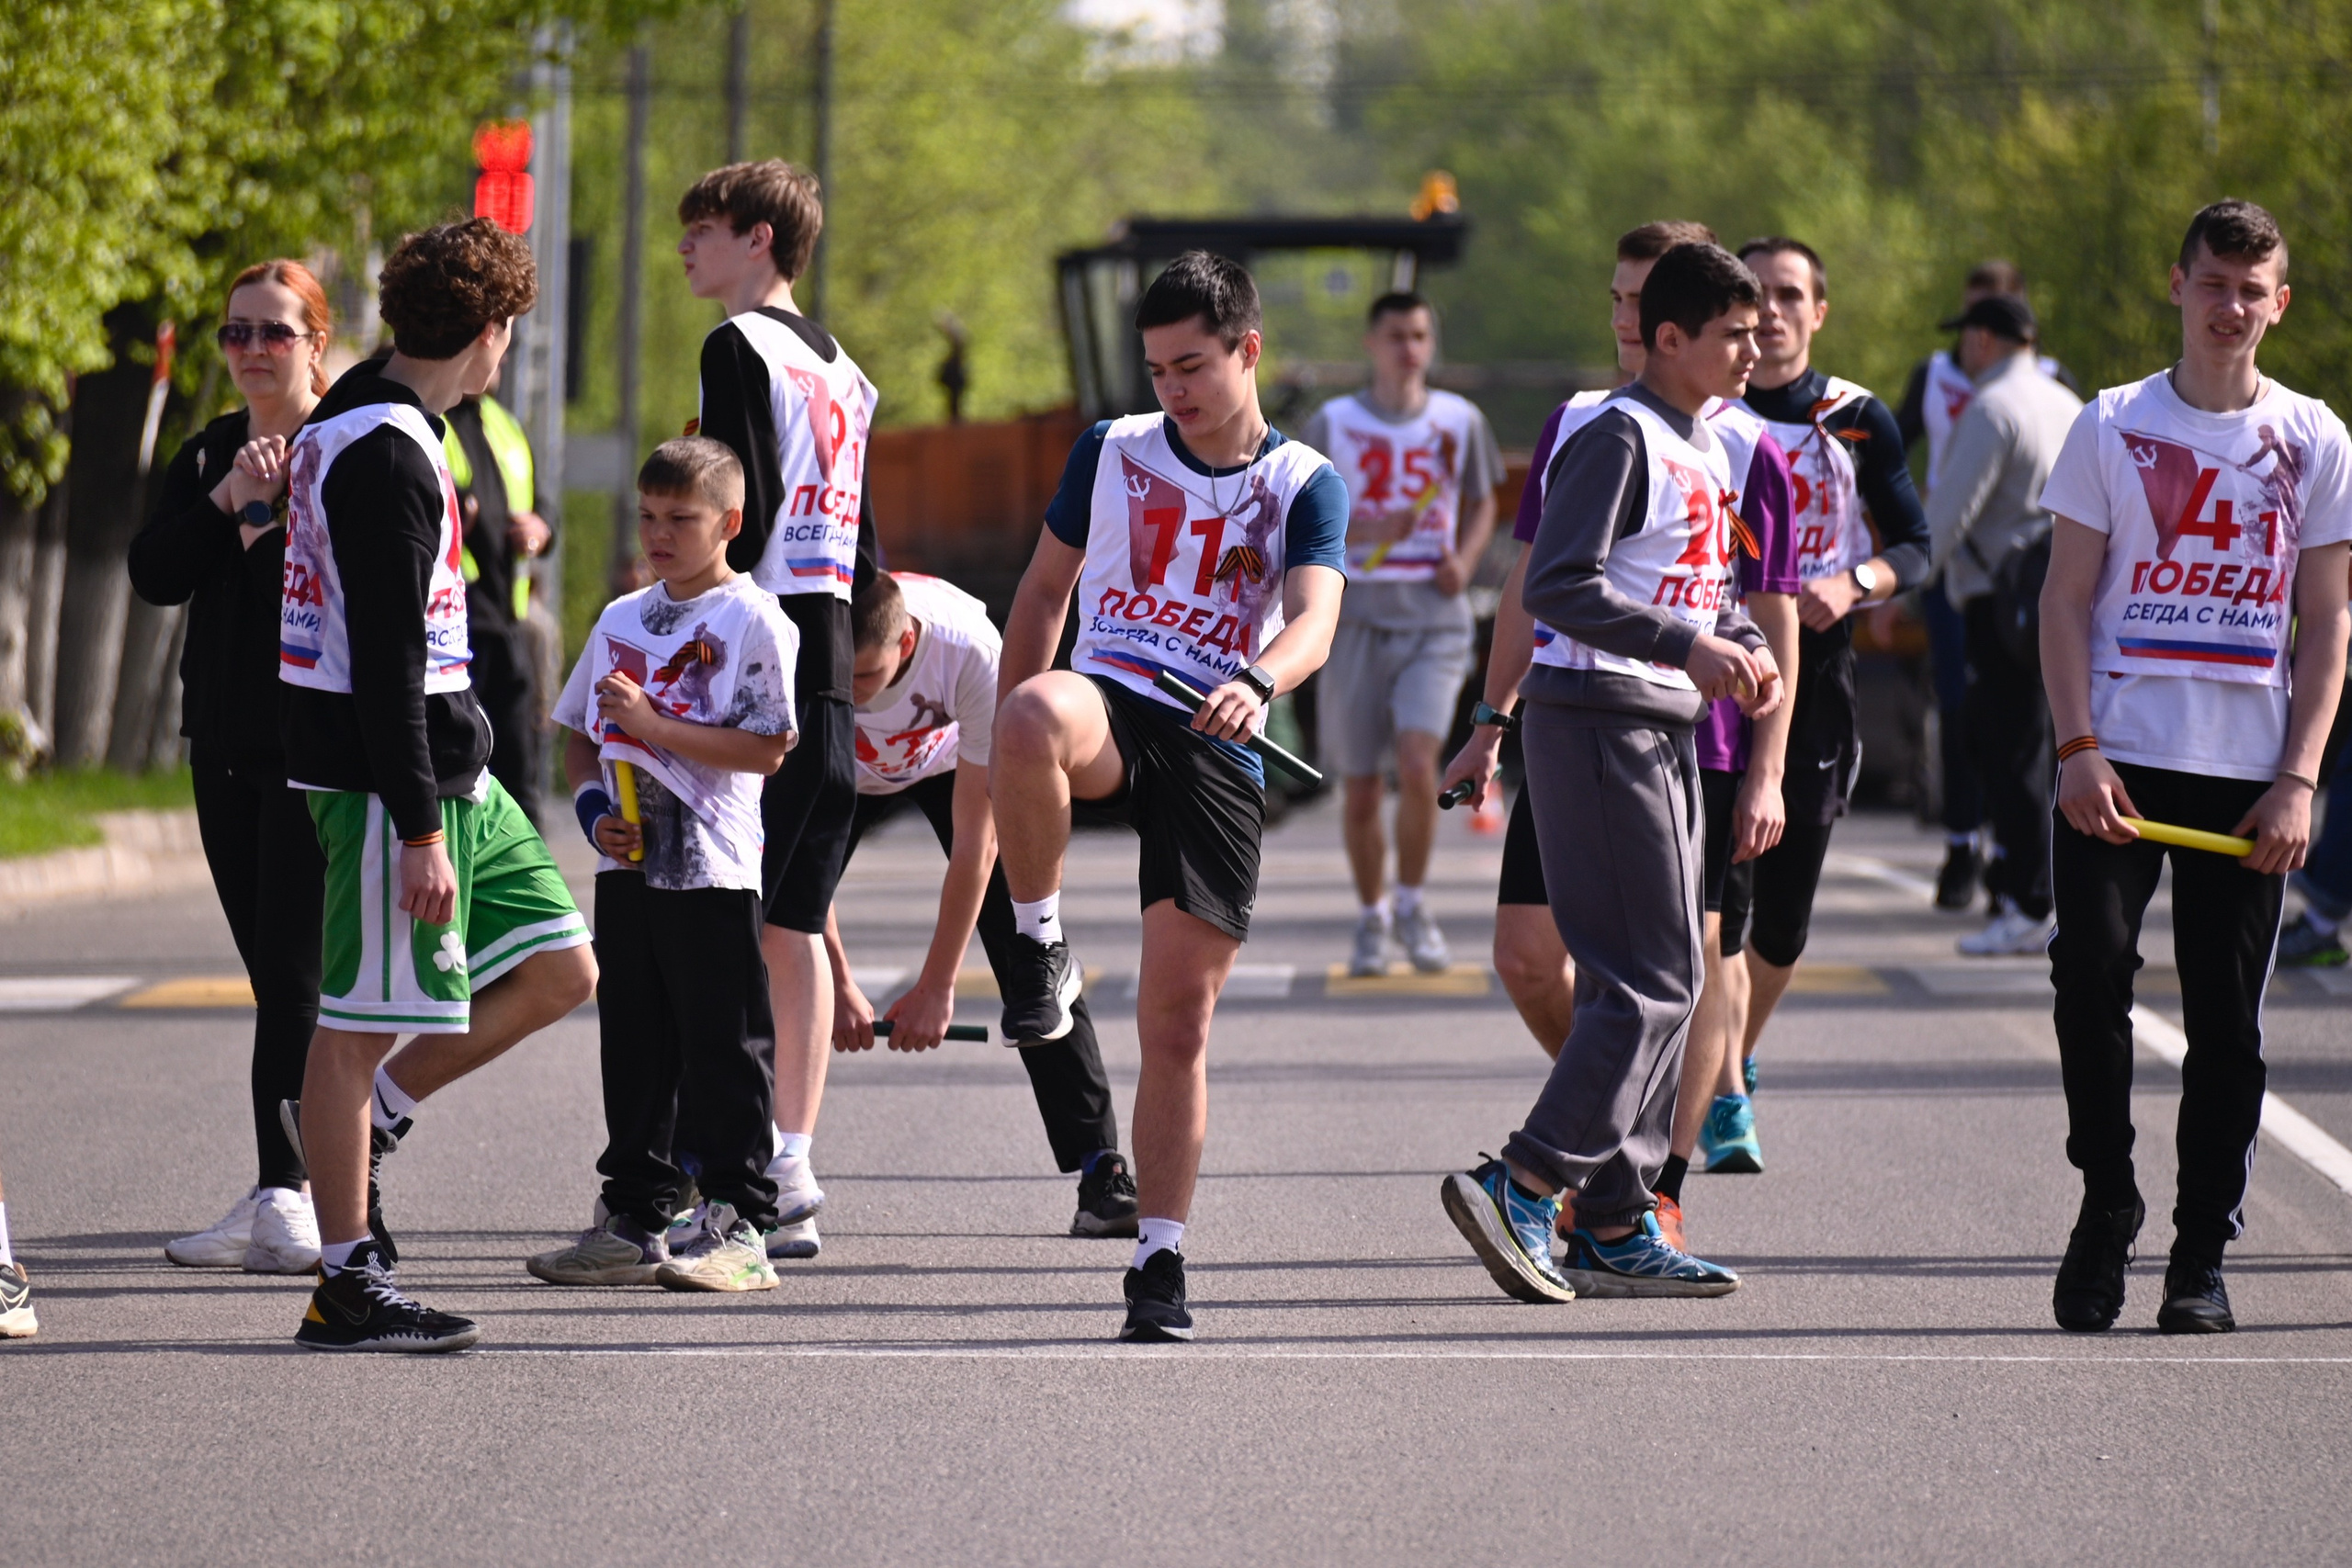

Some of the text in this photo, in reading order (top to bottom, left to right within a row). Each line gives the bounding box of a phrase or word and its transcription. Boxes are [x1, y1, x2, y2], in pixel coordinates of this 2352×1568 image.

[1359, 447, 1431, 501] 25
[2176, 468, 2278, 556] 4 1
[1143, 507, 1226, 597] 11
[2130, 559, 2286, 609] ПОБЕДА
[1098, 587, 1251, 657] ПОБЕДА
[2196, 606, 2214, 624] С
[1165, 637, 1182, 651] С
